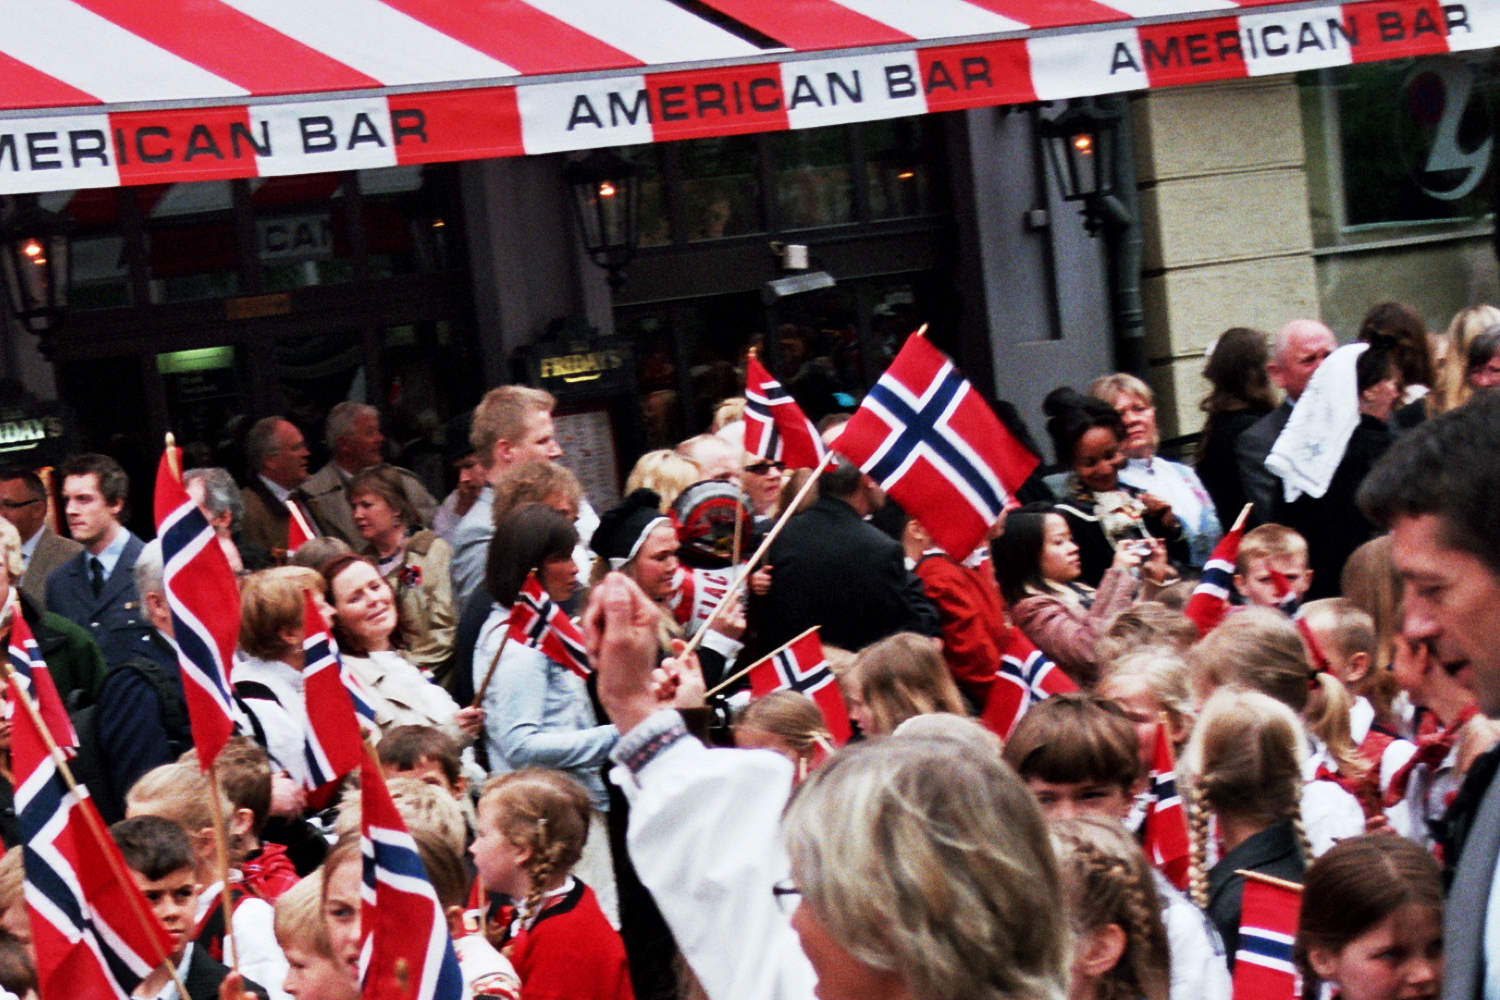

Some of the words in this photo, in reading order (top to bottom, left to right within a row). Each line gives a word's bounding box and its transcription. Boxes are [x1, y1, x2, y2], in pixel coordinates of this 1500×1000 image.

[1109, 15, 1358, 75] AMERICAN
[1376, 3, 1473, 43] BAR
[566, 69, 862, 131] AMERICAN
[884, 55, 993, 99] BAR
[300, 108, 428, 154] BAR
